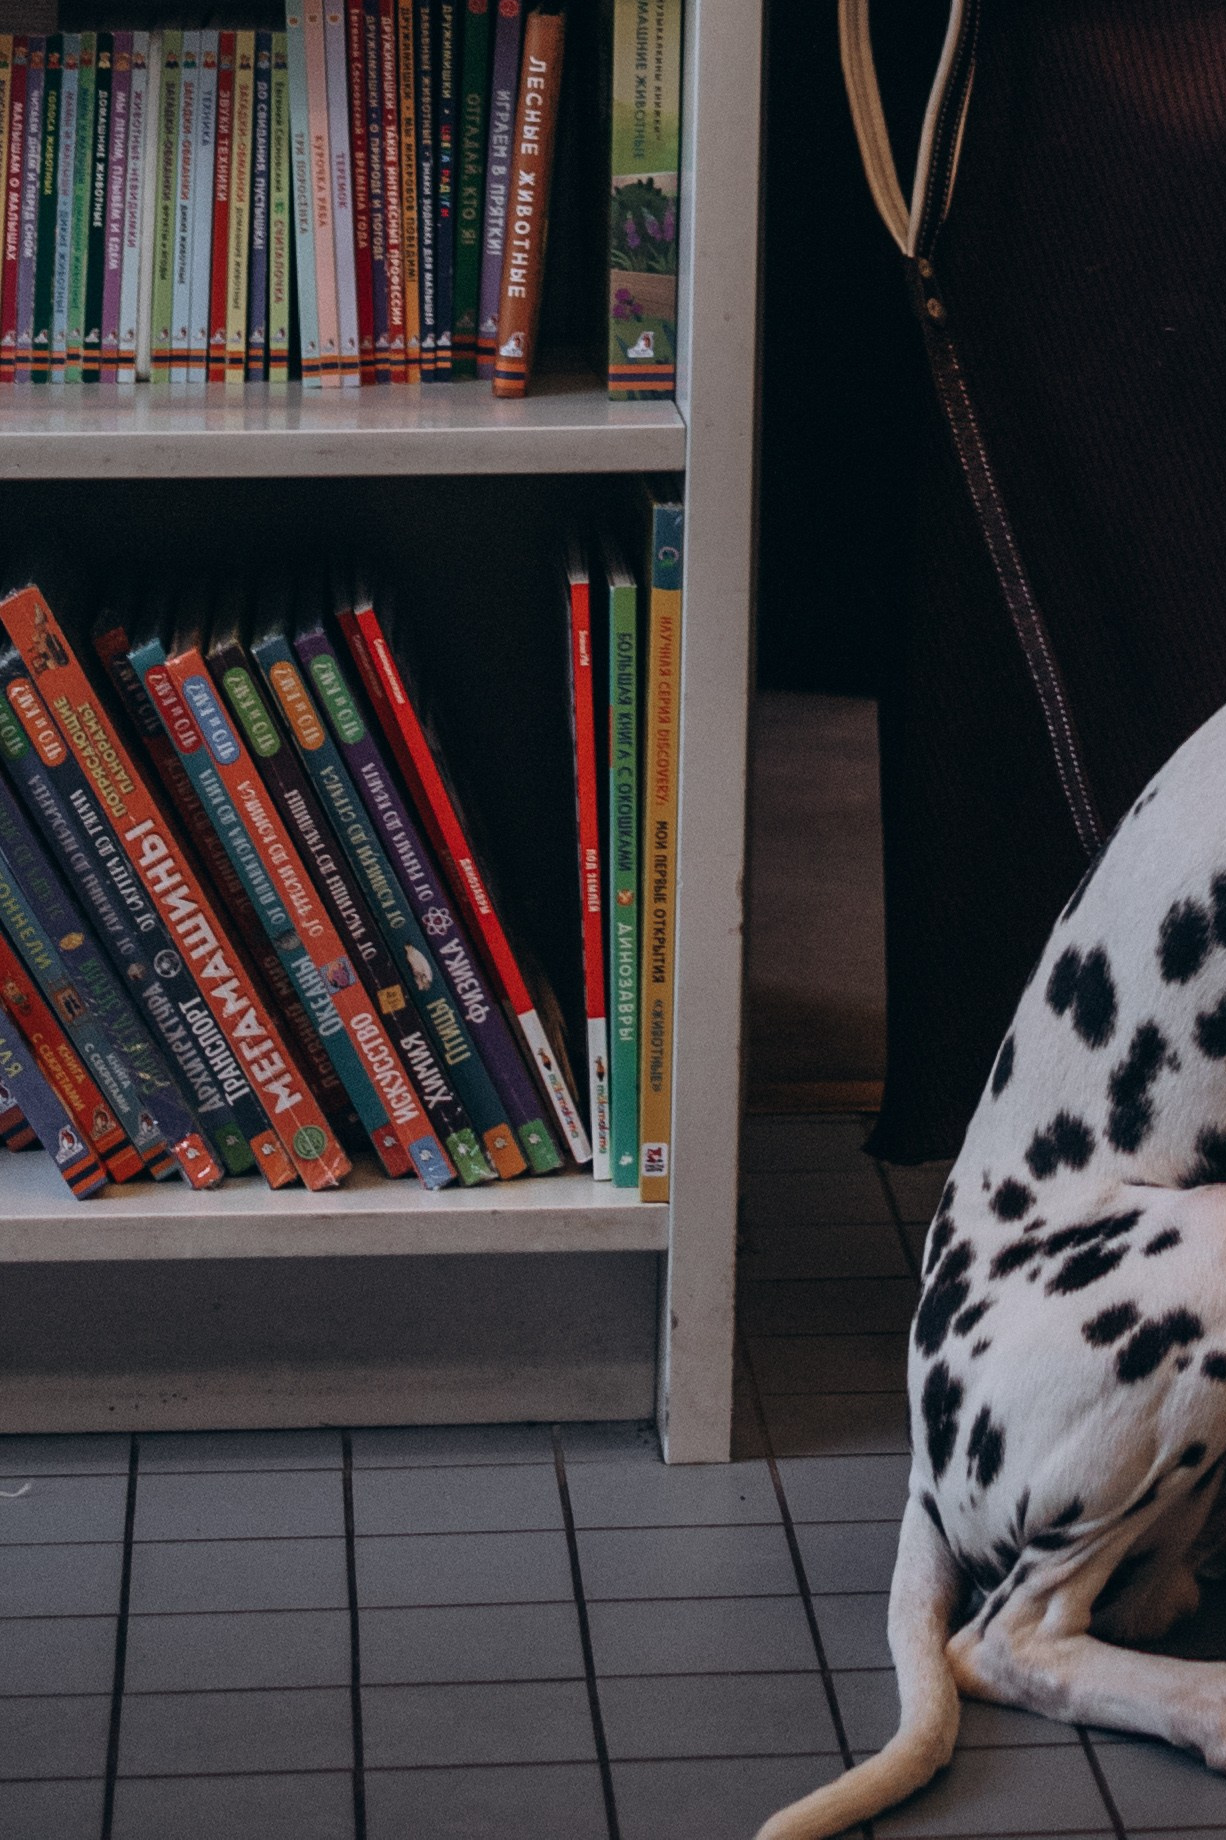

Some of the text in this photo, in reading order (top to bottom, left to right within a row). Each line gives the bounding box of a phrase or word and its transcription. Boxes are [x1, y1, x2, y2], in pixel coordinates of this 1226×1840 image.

[441, 5, 454, 98] ДРУЖИМИШКИ
[201, 90, 213, 147] ТЕХНИКА
[217, 90, 230, 202] ЗВУКИ ТЕХНИКИ
[632, 75, 649, 161] ЖИВОТНЫЕ
[6, 103, 23, 261] МАЛЫШАМ О МАЛЫШАХ
[93, 90, 107, 227] ДОМАШНИЕ ЖИВОТНЫЕ
[252, 81, 267, 250] ДО СВИДАНИЯ, ПУСТЫШКА!
[314, 135, 326, 193] КУРОЧКА
[335, 152, 347, 209] ТЕРЕМОК
[369, 137, 382, 195] ПРИРОДЕ
[381, 16, 402, 325] ДРУЖИМИШКИ ТАКИЕ ИНТЕРЕСНЫЕ ПРОФЕССИИ
[486, 91, 510, 256] ИГРАЕМ В ПРЯТКИ!
[507, 55, 547, 298] ЛЕСНЫЕ ЖИВОТНЫЕ
[22, 224, 34, 258] СНОМ
[24, 185, 35, 220] ПЕРЕД
[372, 214, 385, 262] ПОГОДЕ
[462, 229, 475, 245] Я!
[463, 187, 477, 222] КТО
[658, 615, 674, 676] НАУЧНАЯ
[657, 680, 672, 724] СЕРИЯ
[52, 693, 128, 819] ПОТРЯСАЮЩИЕ
[75, 699, 136, 796] ПАНОРАМЫ
[614, 632, 634, 1039] БОЛЬШАЯ КНИГА С ОКОШКАМИ ДИНОЗАВРЫ
[653, 820, 668, 849] МОИ
[652, 854, 667, 904] ПЕРВЫЕ
[122, 813, 304, 1117] МЕГАМАШИНЫ
[436, 937, 495, 1027] ФИЗИКА
[649, 909, 667, 983] ОТКРЫТИЯ
[285, 954, 345, 1039] ОКЕАНЫ
[422, 996, 473, 1066] ПТИЦЫ
[37, 1041, 85, 1113] СЕКРЕТАМИ
[83, 1041, 131, 1115] С СЕКРЕТАМИ
[106, 1053, 131, 1089] КНИГА
[177, 994, 246, 1106] ТРАНСПОРТ
[345, 1009, 420, 1126] ИСКУССТВО
[397, 1028, 454, 1110] ХИМИЯ
